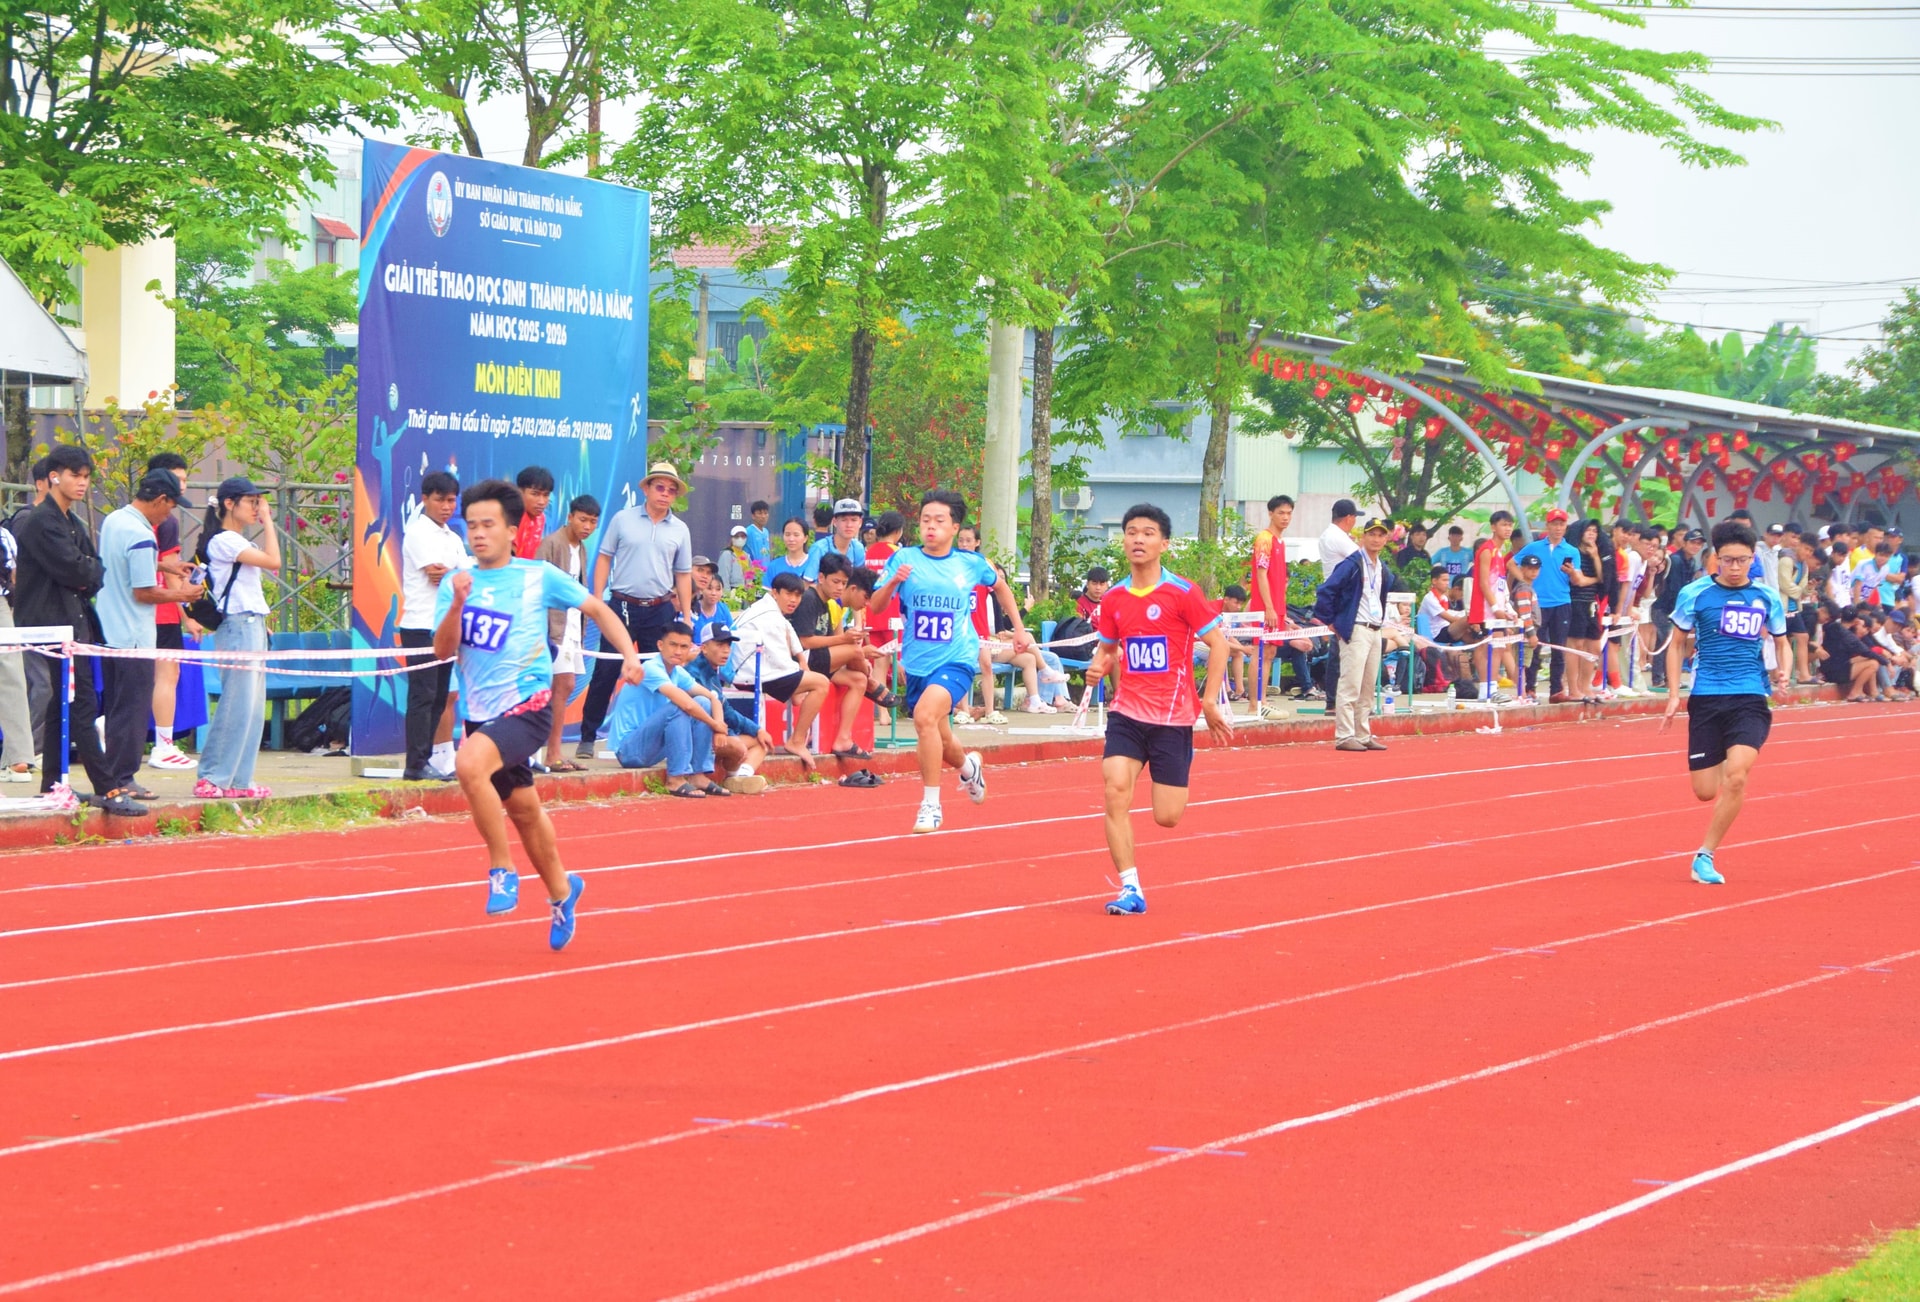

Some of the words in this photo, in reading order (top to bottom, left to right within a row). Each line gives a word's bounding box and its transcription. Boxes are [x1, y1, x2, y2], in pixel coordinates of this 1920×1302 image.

[455, 176, 464, 198] ỦY
[466, 183, 481, 200] BAN
[482, 184, 502, 204] NHÂN
[504, 187, 517, 206] DÂN
[519, 190, 540, 210] THÀNH
[542, 193, 554, 212] PHỐ
[555, 196, 564, 214] ĐÀ
[480, 207, 490, 228] SỞ
[491, 211, 508, 231] GIÁO
[510, 216, 523, 235] DỤC
[524, 216, 533, 234] VÀ
[534, 218, 548, 237] ĐÀO
[549, 222, 562, 241] TẠO
[385, 259, 414, 294] GIẢI
[416, 261, 438, 296] THỂ
[440, 270, 474, 301] THAO
[477, 275, 500, 306] HỌC
[502, 278, 526, 307] SINH
[530, 282, 565, 312] THÀNH
[566, 284, 588, 315] PHỐ
[590, 289, 604, 317] ĐÀ
[470, 311, 494, 338] NĂM
[496, 316, 517, 342] HỌC
[518, 319, 540, 343] 2025
[546, 322, 567, 346] 2026
[475, 360, 505, 394] MÔN
[507, 360, 532, 396] ĐIỀN
[535, 368, 560, 399] KINH
[408, 408, 427, 428] Thời
[427, 411, 448, 434] gian
[450, 412, 462, 430] thi
[462, 409, 479, 432] đấu
[480, 413, 490, 432] từ
[490, 414, 510, 438] ngày
[511, 417, 556, 438] 25/03/2026
[557, 417, 571, 438] đến
[572, 420, 612, 441] 29/03/2026
[913, 595, 960, 609] KEYBALL
[463, 612, 509, 648] 137
[917, 616, 952, 640] 213
[1725, 610, 1762, 636] 350
[1129, 642, 1166, 669] 049
